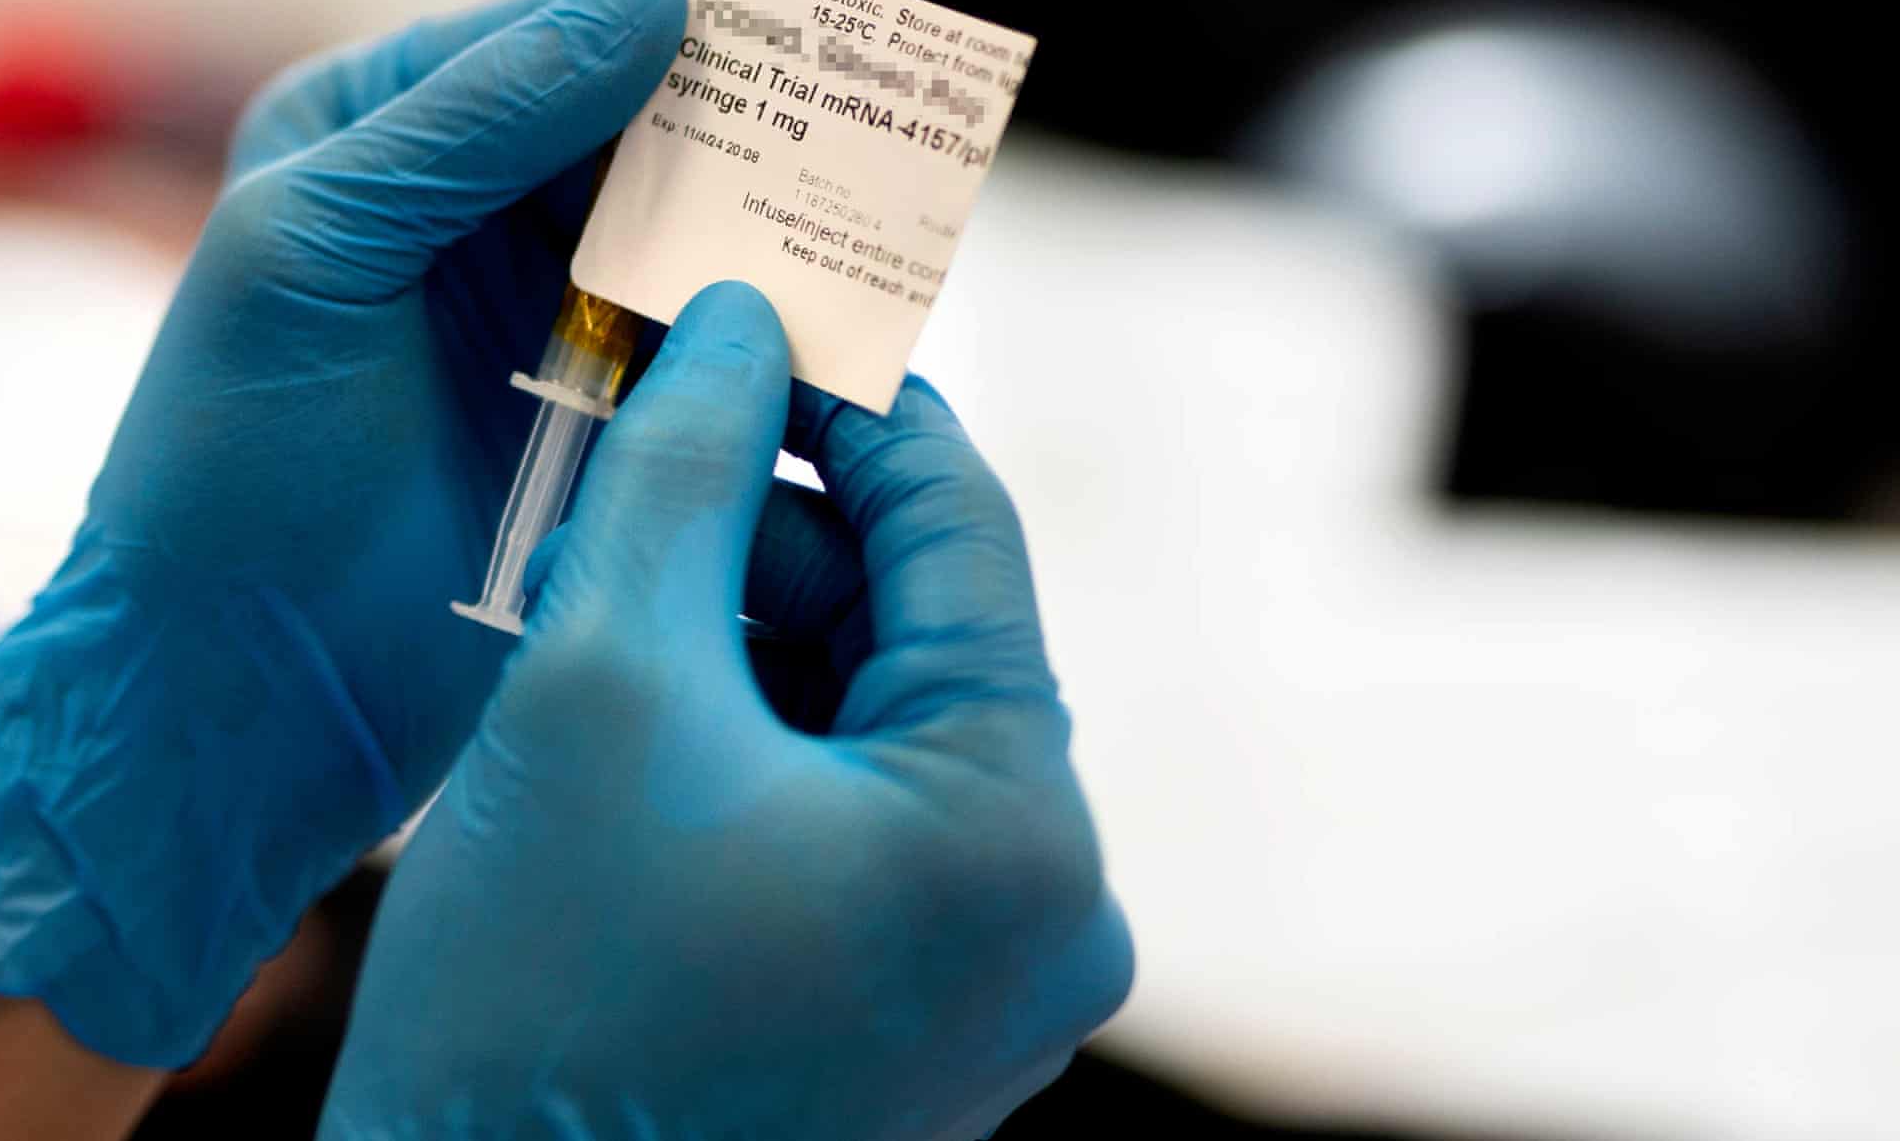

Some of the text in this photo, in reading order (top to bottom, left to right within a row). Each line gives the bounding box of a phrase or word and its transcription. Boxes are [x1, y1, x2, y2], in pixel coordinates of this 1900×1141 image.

[887, 32, 949, 67] Protect
[952, 55, 994, 82] from
[895, 8, 942, 37] Store
[945, 29, 963, 45] at
[966, 35, 1011, 60] room
[680, 37, 763, 83] Clinical
[769, 67, 819, 103] Trial
[668, 72, 809, 141] syringe 1 mg
[798, 167, 833, 191] Batch
[742, 191, 849, 249] Infuse/inject
[852, 239, 903, 269] entire
[781, 235, 817, 266] Keep
[820, 255, 844, 274] out
[846, 264, 864, 280] of
